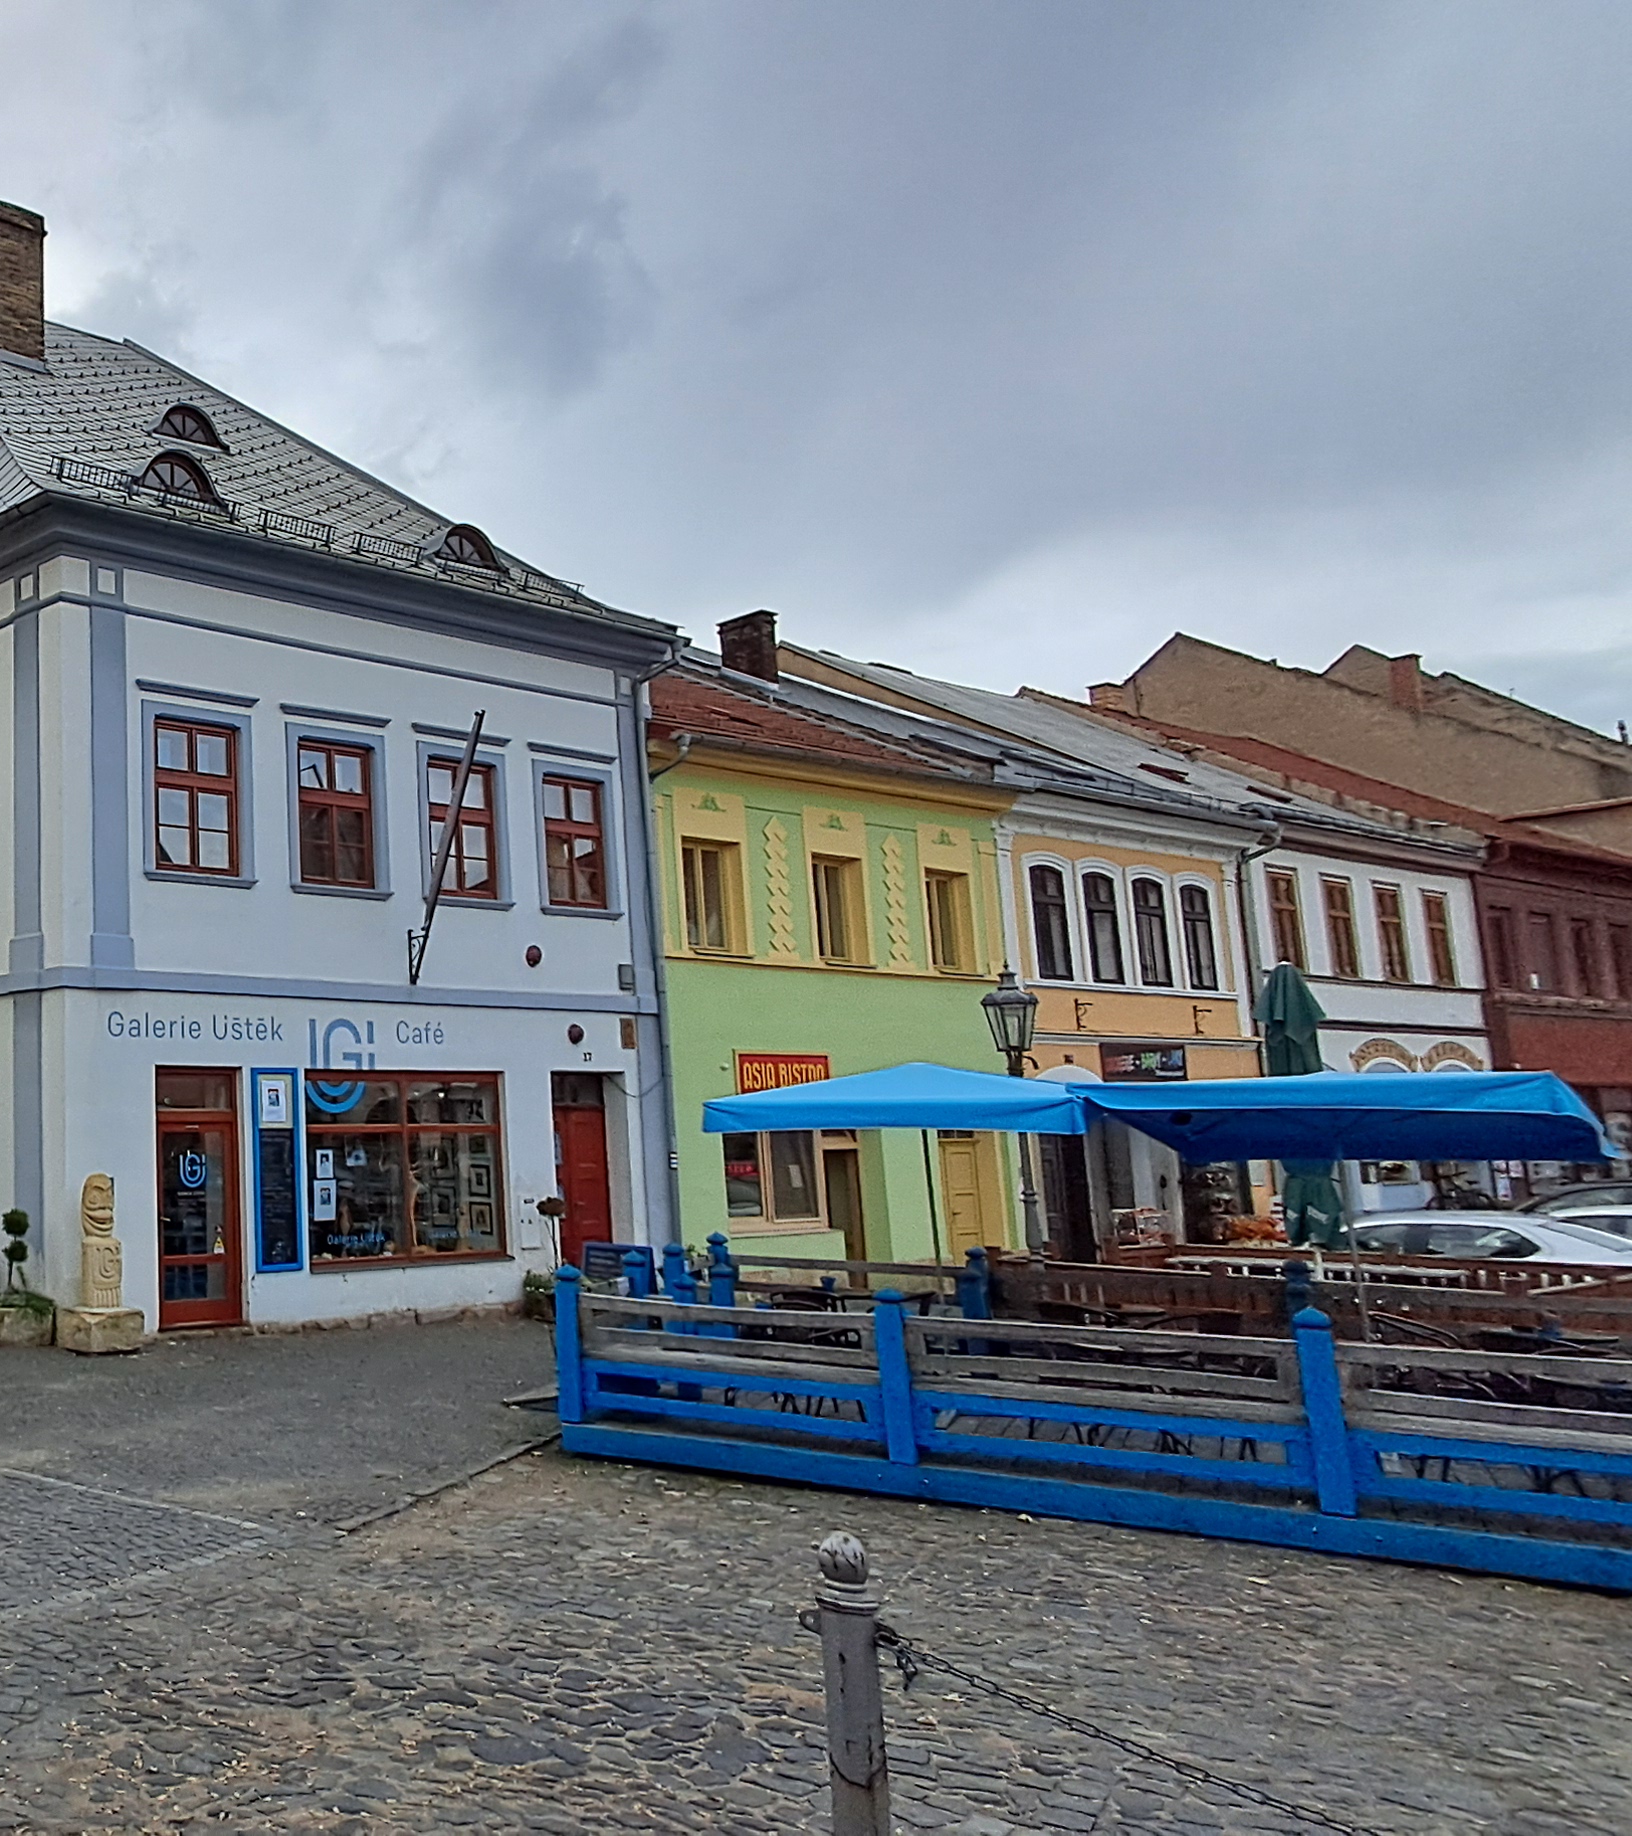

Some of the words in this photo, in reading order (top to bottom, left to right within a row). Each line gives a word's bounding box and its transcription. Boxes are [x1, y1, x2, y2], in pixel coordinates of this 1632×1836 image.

[107, 1010, 202, 1040] Galerie
[396, 1020, 445, 1045] Café
[743, 1062, 776, 1090] ASIA
